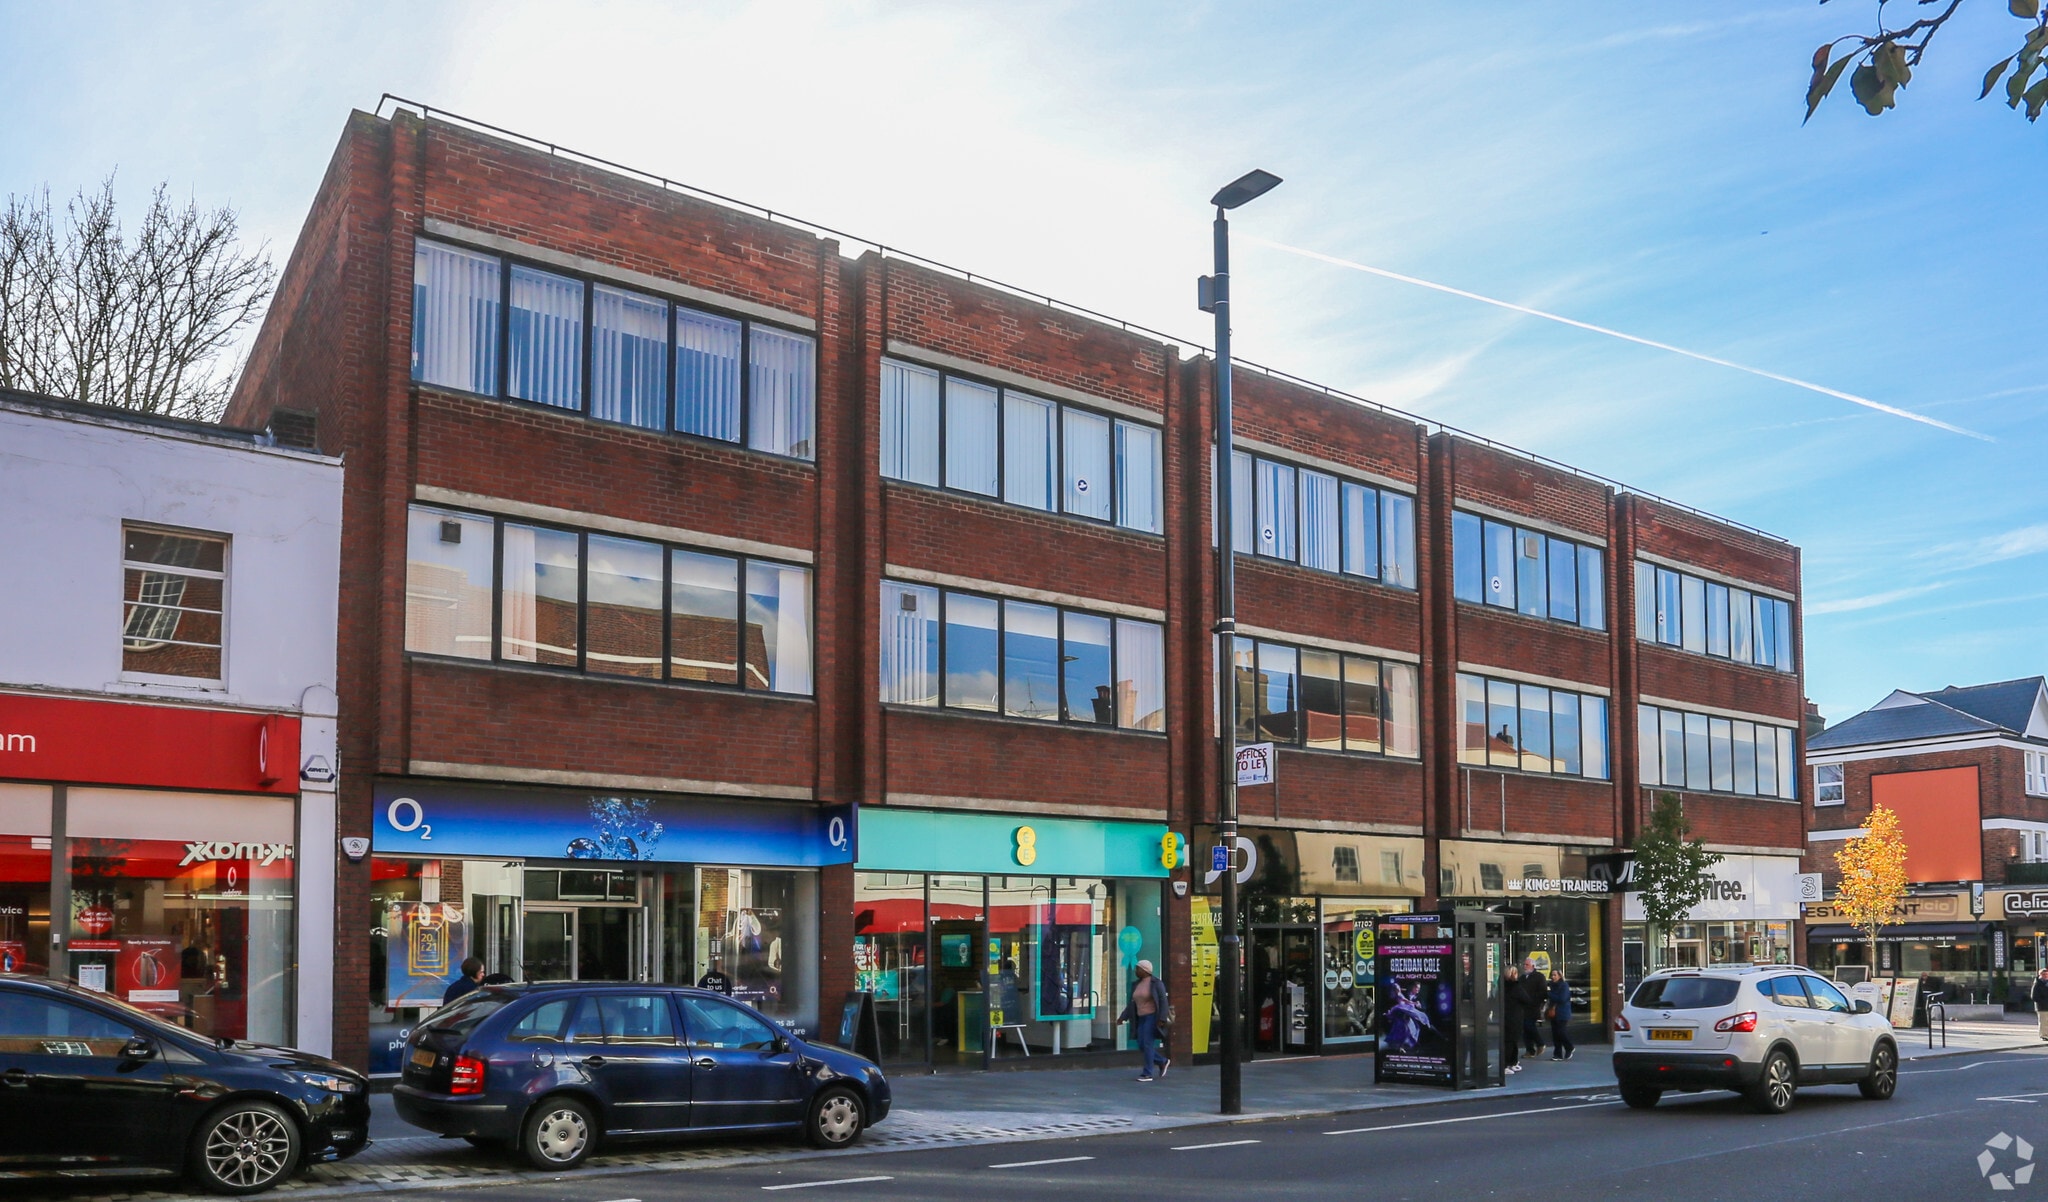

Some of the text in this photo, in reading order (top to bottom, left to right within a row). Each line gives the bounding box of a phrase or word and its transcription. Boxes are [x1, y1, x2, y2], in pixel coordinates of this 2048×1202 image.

[1236, 747, 1267, 760] OFFICES
[1237, 760, 1248, 771] TO
[388, 798, 432, 840] O2
[829, 816, 848, 851] O2
[1525, 879, 1549, 892] KING
[1562, 880, 1608, 893] TRAINERS
[1390, 958, 1440, 972] BRENDAN COLE
